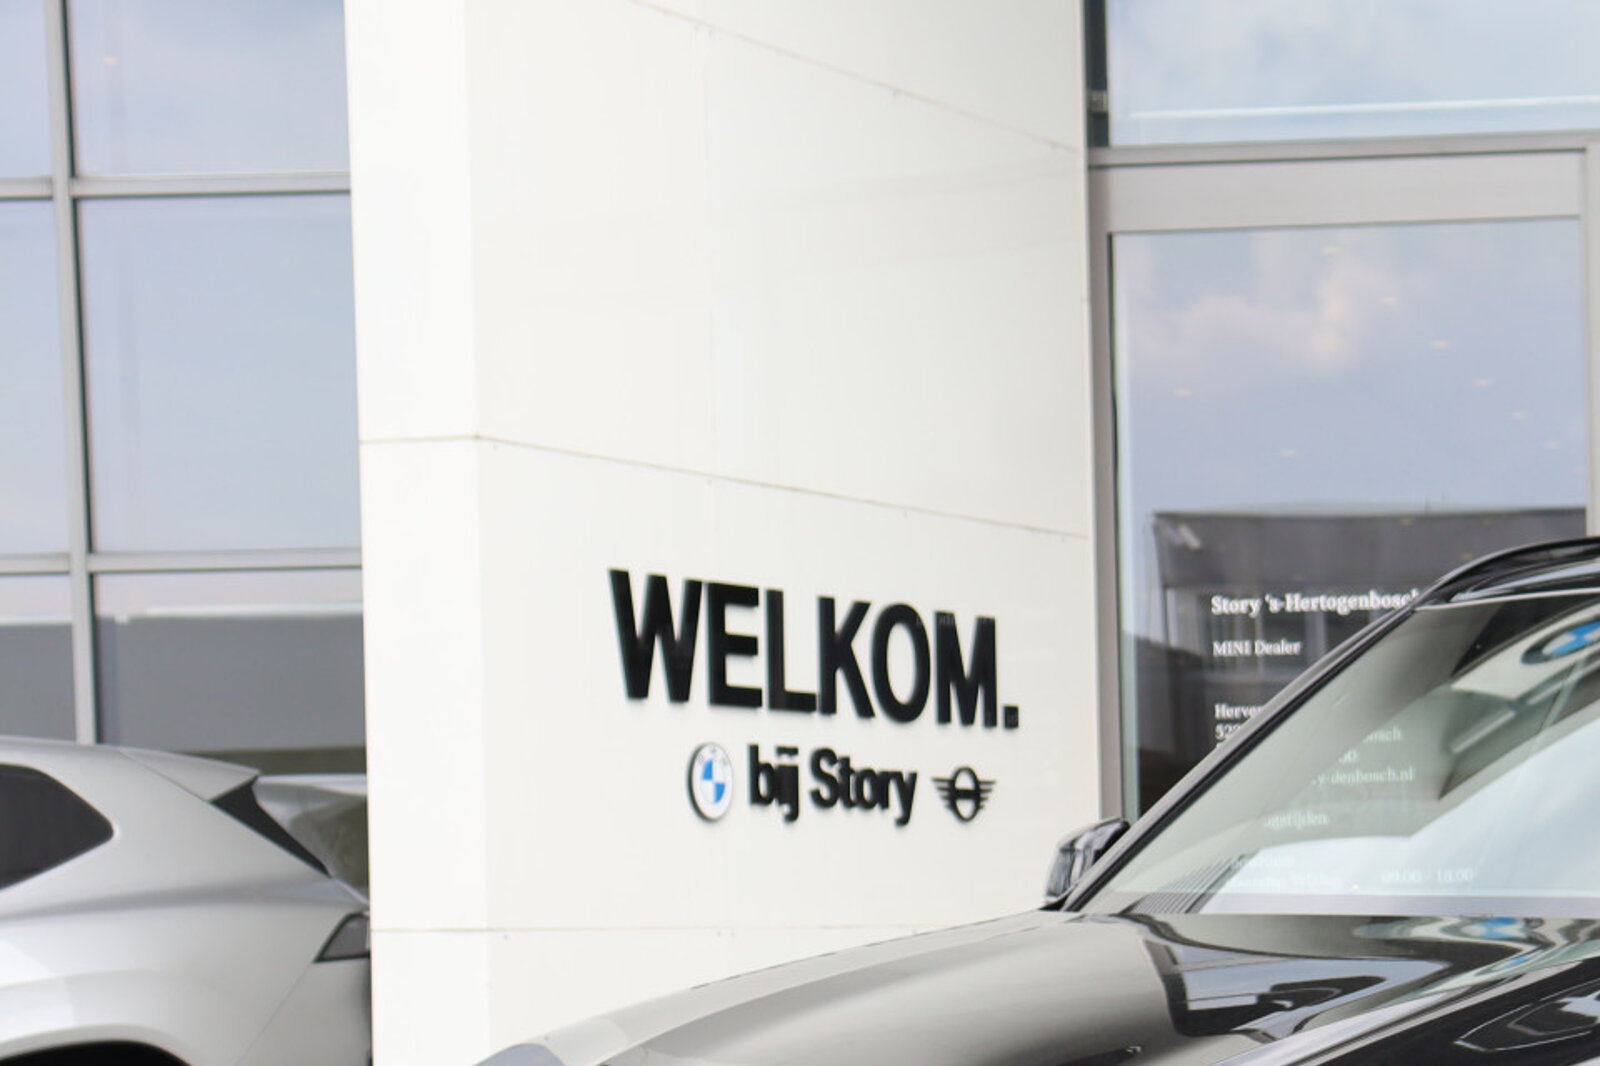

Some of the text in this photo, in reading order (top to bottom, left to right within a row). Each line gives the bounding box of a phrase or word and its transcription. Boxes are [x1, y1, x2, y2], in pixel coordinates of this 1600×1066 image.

[1211, 594, 1261, 617] Story
[608, 569, 1019, 729] WELKOM.
[1213, 637, 1302, 656] MINI Dealer
[809, 746, 918, 827] Story
